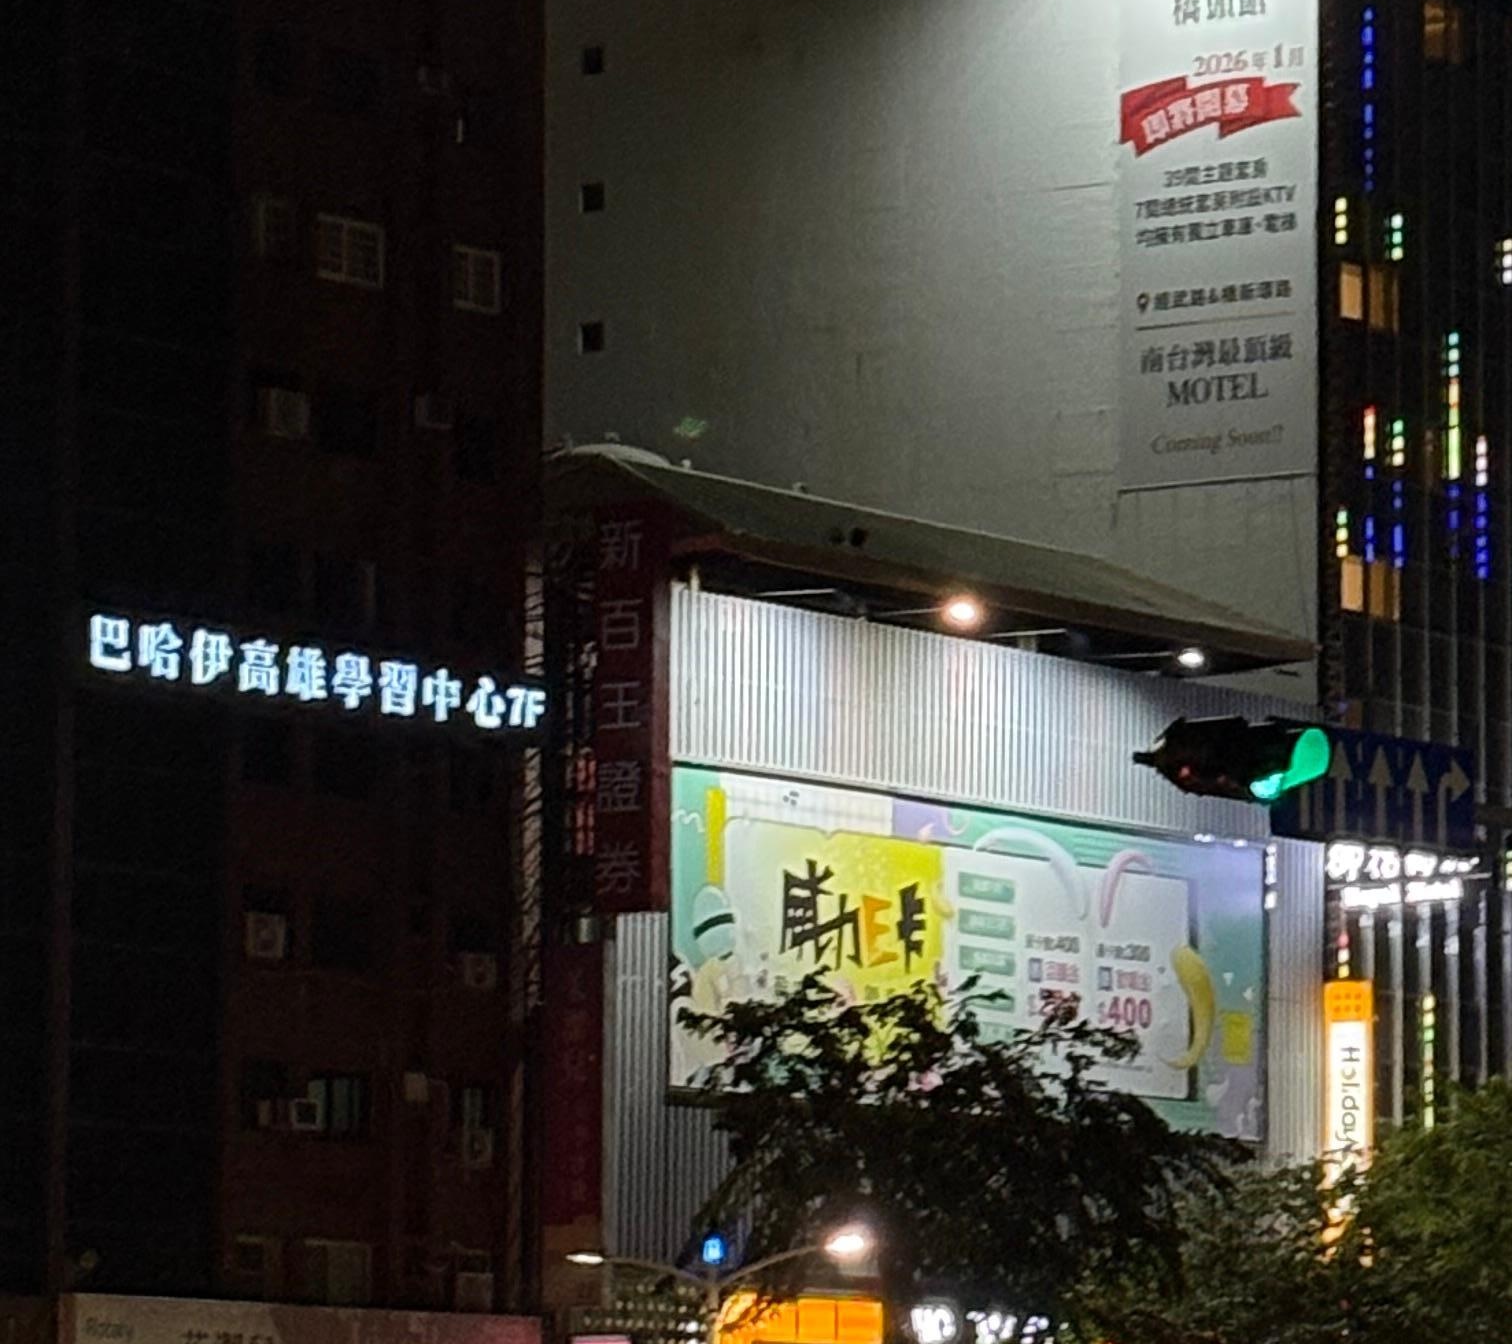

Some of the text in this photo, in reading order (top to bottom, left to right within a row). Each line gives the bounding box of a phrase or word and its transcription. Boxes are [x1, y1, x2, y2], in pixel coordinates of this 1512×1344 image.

[1167, 372, 1268, 407] MOTEL
[89, 613, 546, 730] 巴哈伊高雄學習中心7F
[597, 518, 643, 897] 新百王證券
